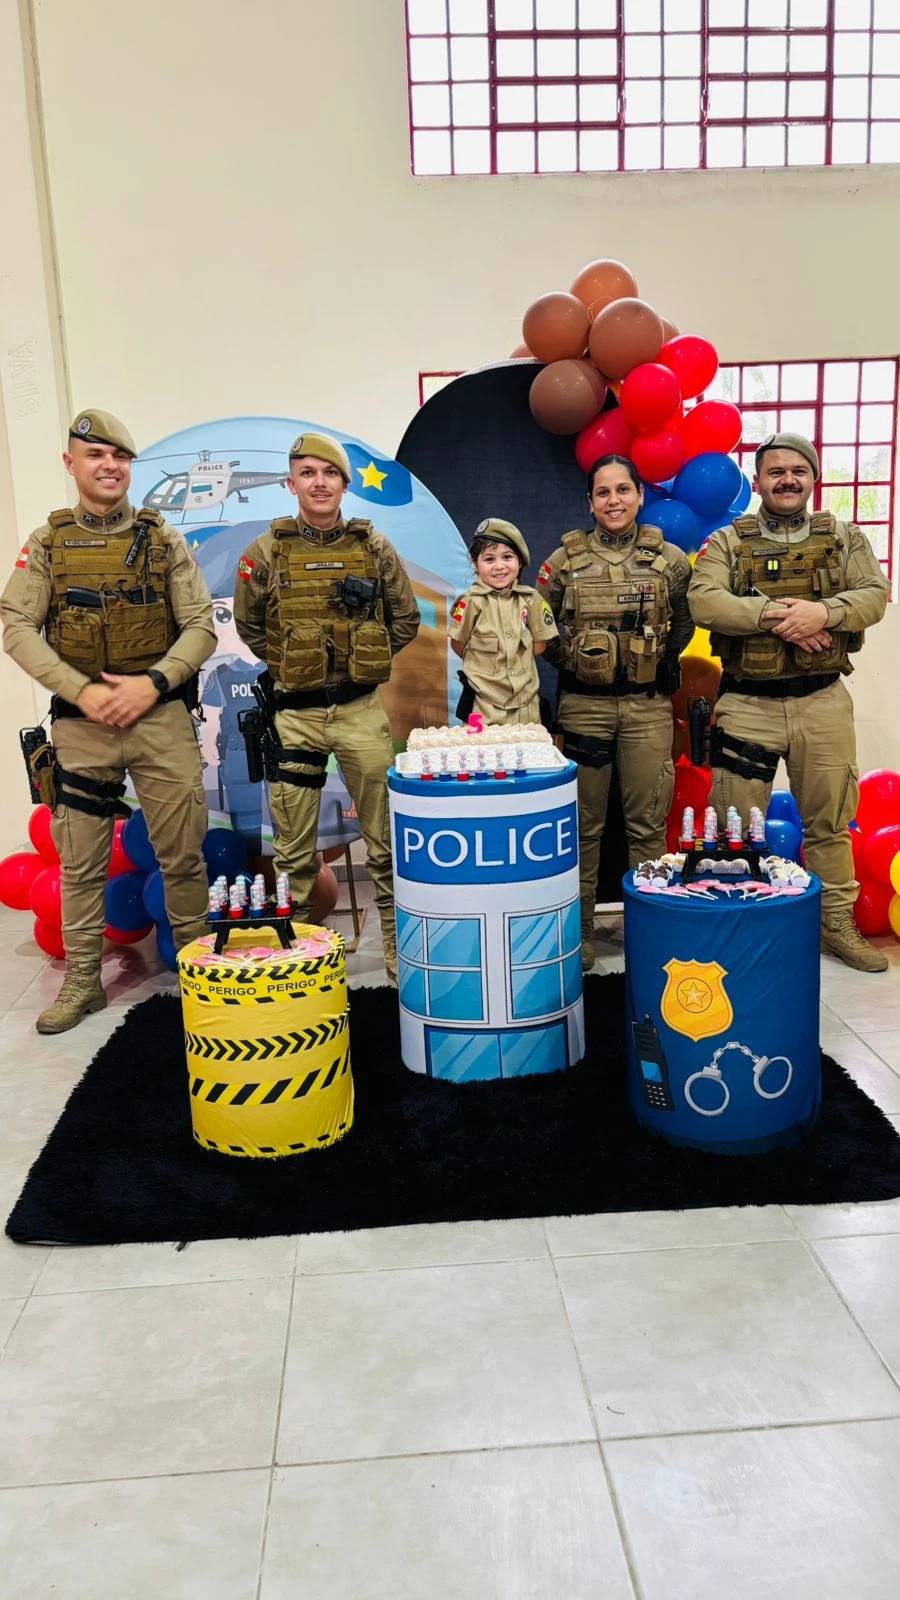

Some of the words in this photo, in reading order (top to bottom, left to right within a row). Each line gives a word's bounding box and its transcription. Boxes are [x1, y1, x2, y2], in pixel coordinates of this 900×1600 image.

[467, 712, 483, 734] 5
[403, 816, 572, 868] POLICE
[208, 986, 257, 996] PERIGO
[267, 978, 317, 993] PERIGO
